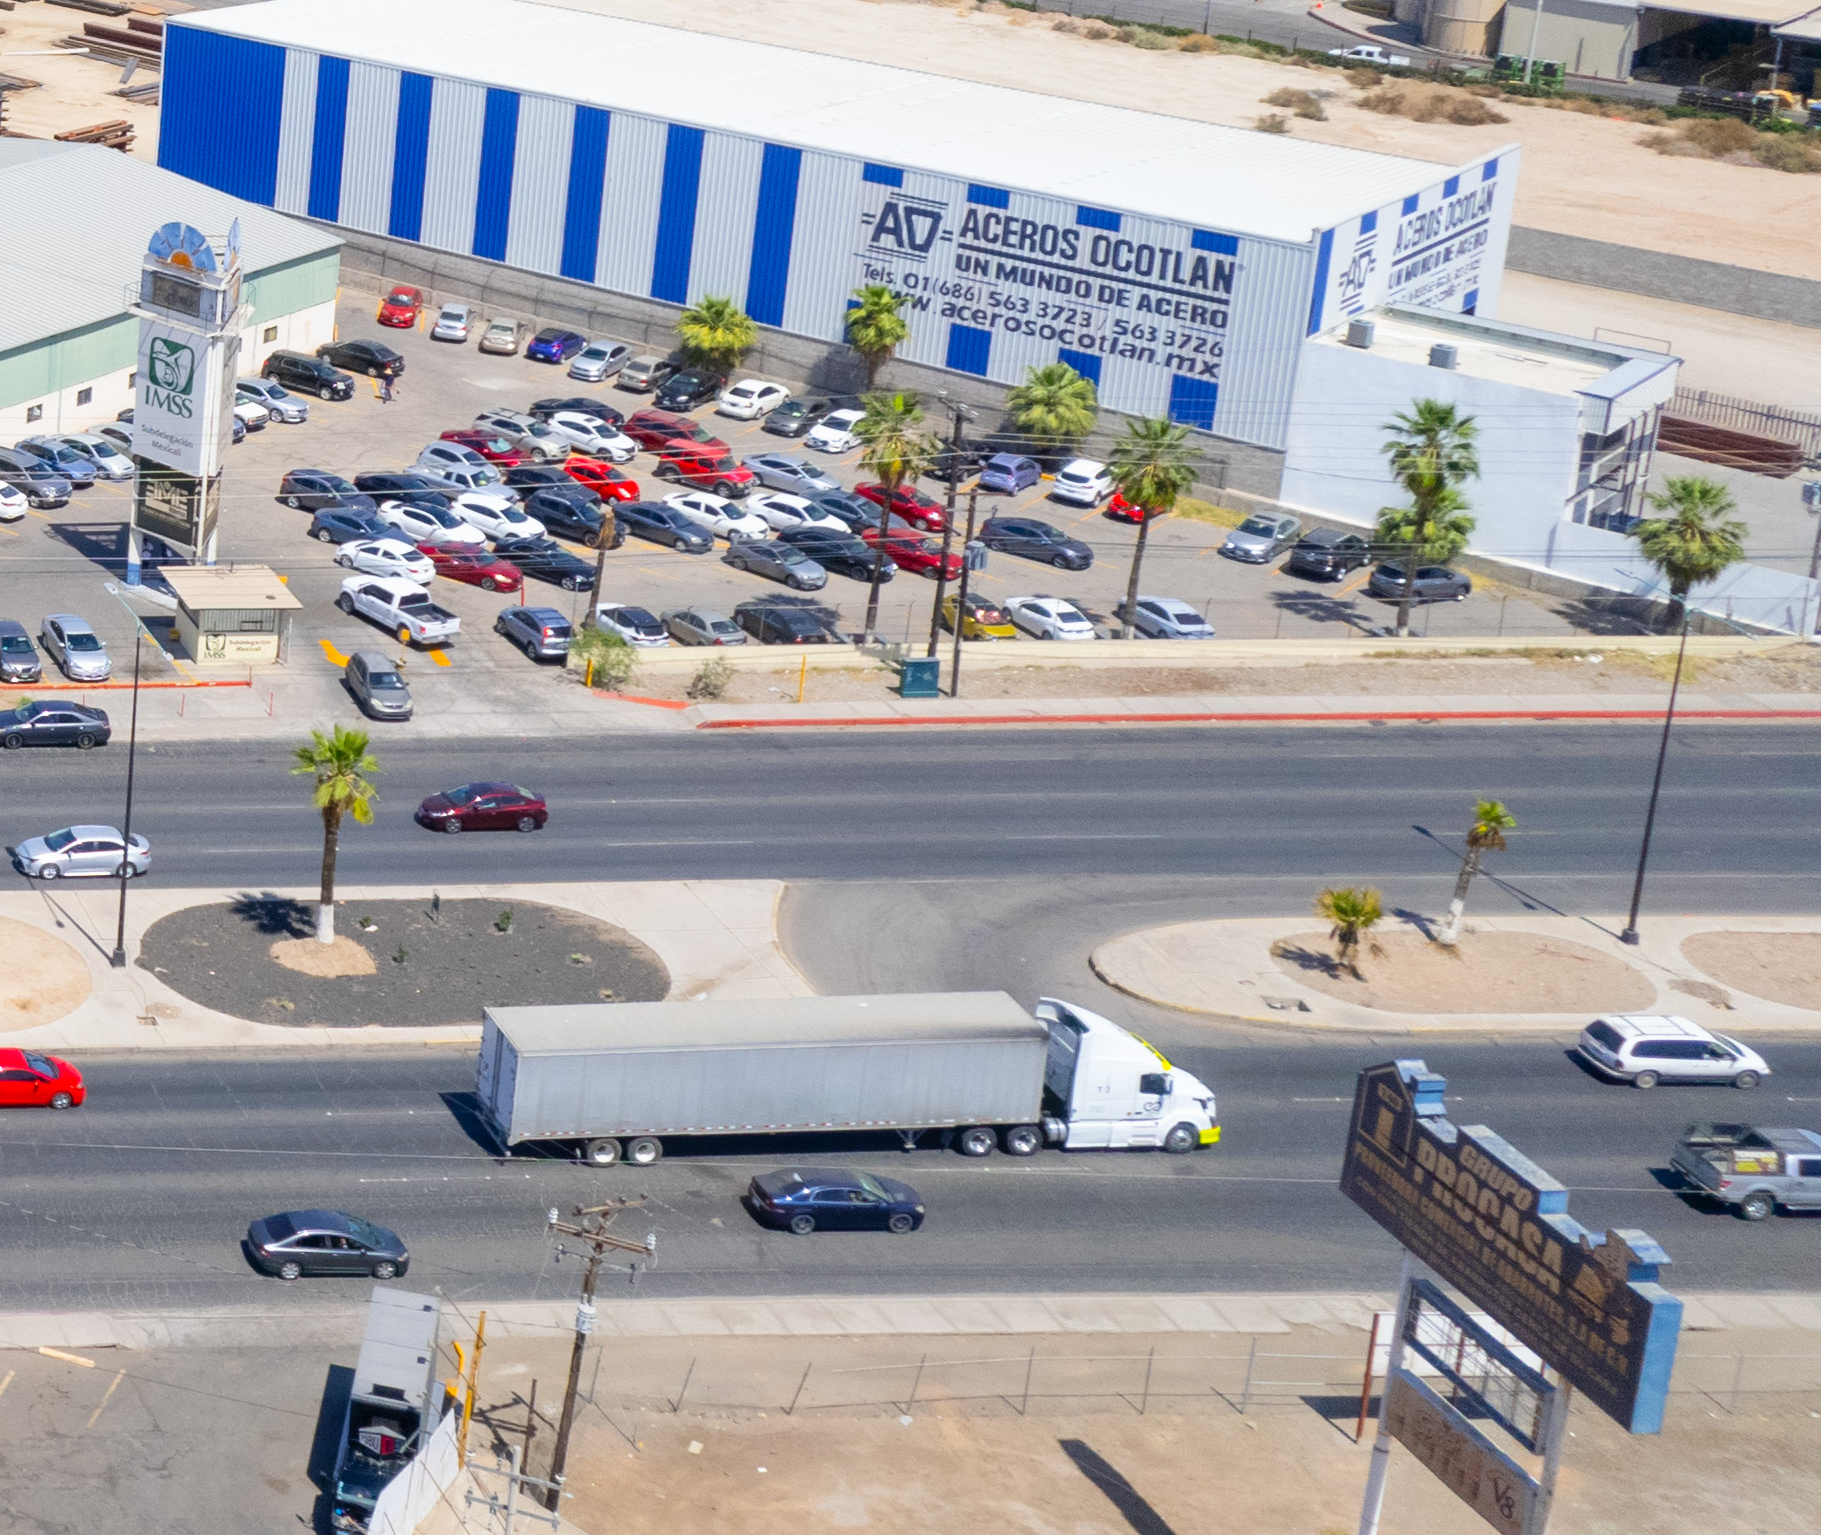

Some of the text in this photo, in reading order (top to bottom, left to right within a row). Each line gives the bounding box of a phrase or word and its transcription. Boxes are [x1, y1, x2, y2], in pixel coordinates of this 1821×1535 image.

[959, 208, 1235, 294] ACEROS OCOTLAN
[863, 263, 897, 284] Tels.
[988, 291, 1030, 315] 563
[1036, 301, 1092, 328] 3723
[1112, 318, 1158, 343] 563
[1162, 329, 1224, 358] 3726
[956, 253, 1228, 329] UN MUNDO DE ACERO
[145, 384, 193, 419] IMSS
[151, 439, 181, 457] Mexicali
[1459, 1144, 1534, 1211] GRUPO
[1413, 1136, 1563, 1305] PROCASA
